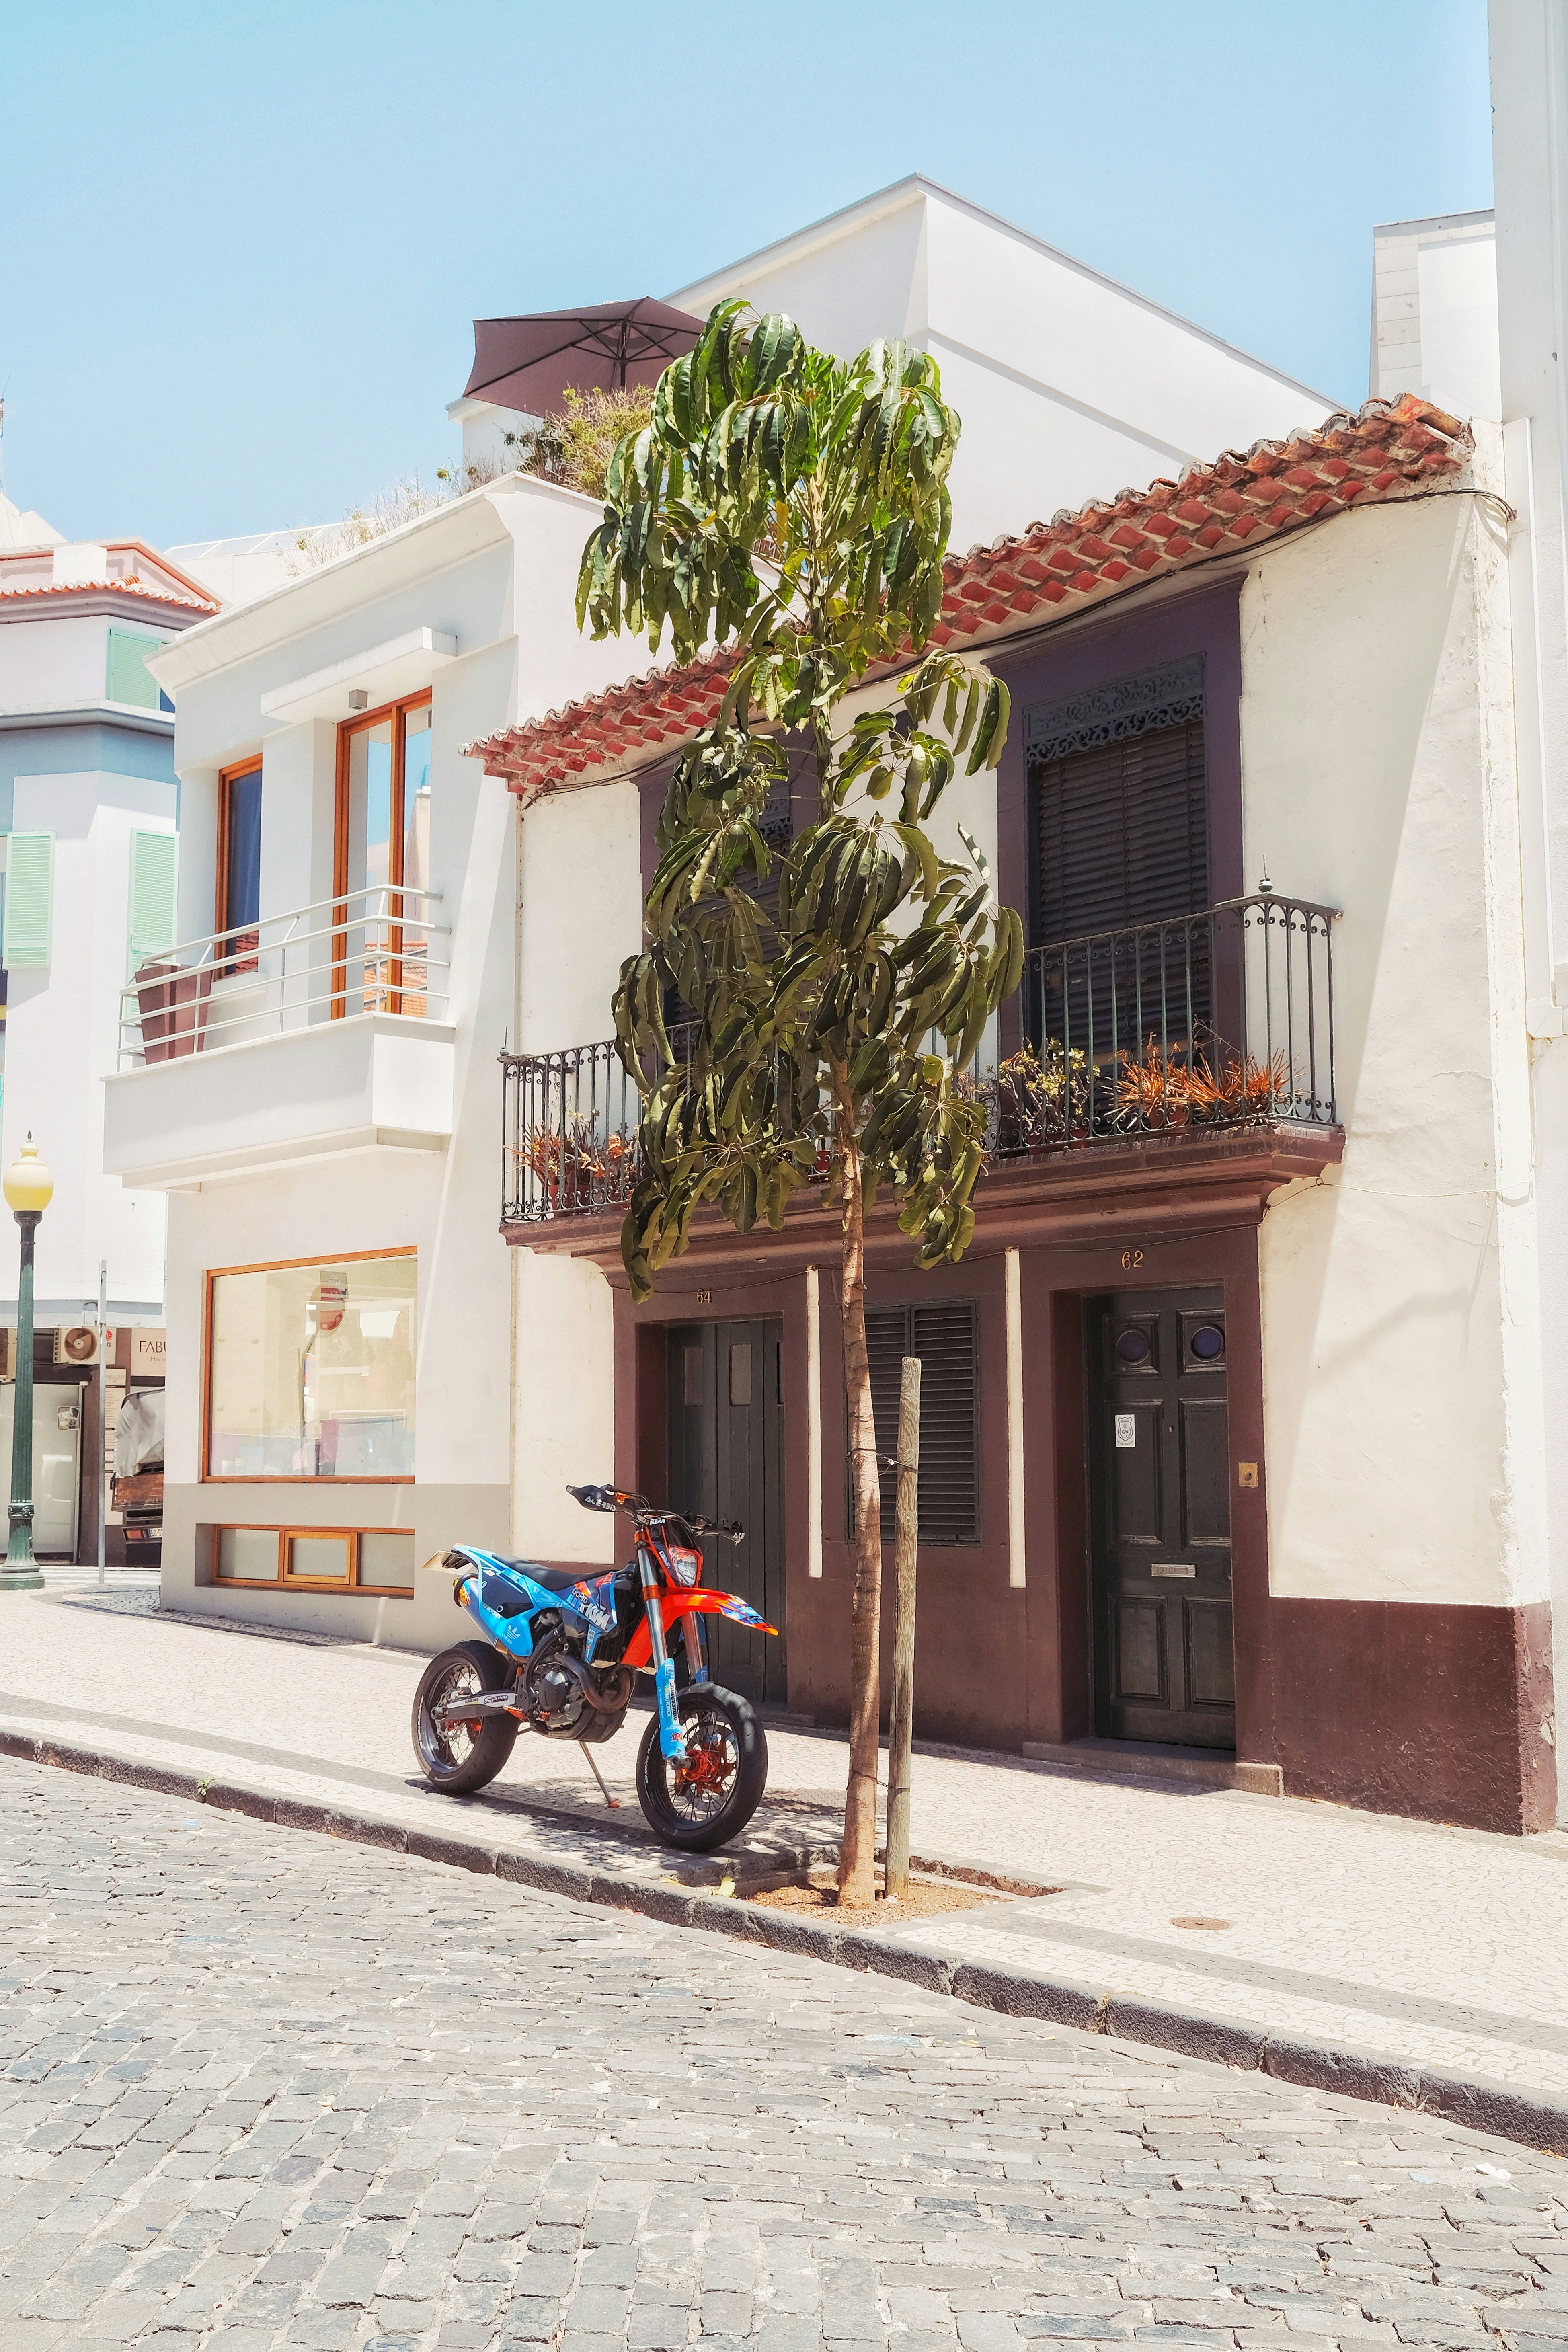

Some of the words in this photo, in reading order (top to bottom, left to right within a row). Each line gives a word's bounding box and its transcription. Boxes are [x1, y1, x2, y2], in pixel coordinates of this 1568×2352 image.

[1121, 1250, 1143, 1270] 62
[697, 1288, 711, 1303] 64
[501, 1633, 514, 1644] adidas
